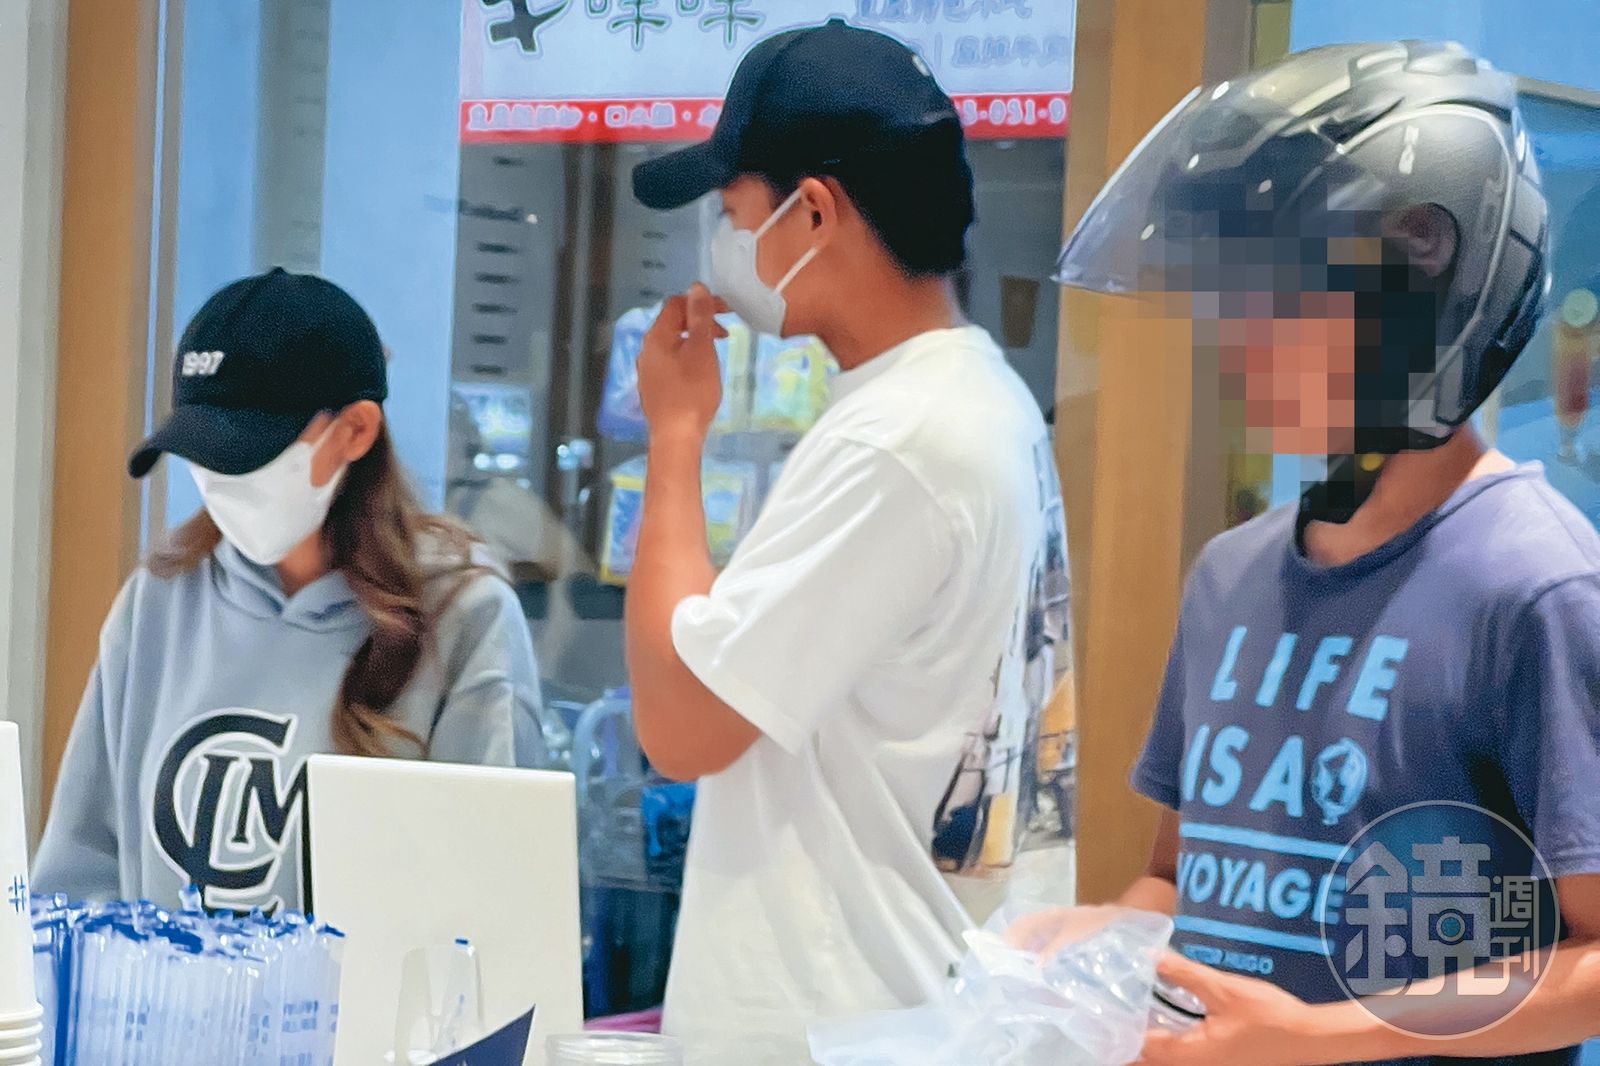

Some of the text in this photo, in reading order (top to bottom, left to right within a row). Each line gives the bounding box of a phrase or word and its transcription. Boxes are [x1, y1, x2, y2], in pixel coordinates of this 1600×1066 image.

[1210, 625, 1409, 721] LIFE
[1182, 725, 1303, 818] IS A
[1176, 851, 1346, 925] VOYAGE
